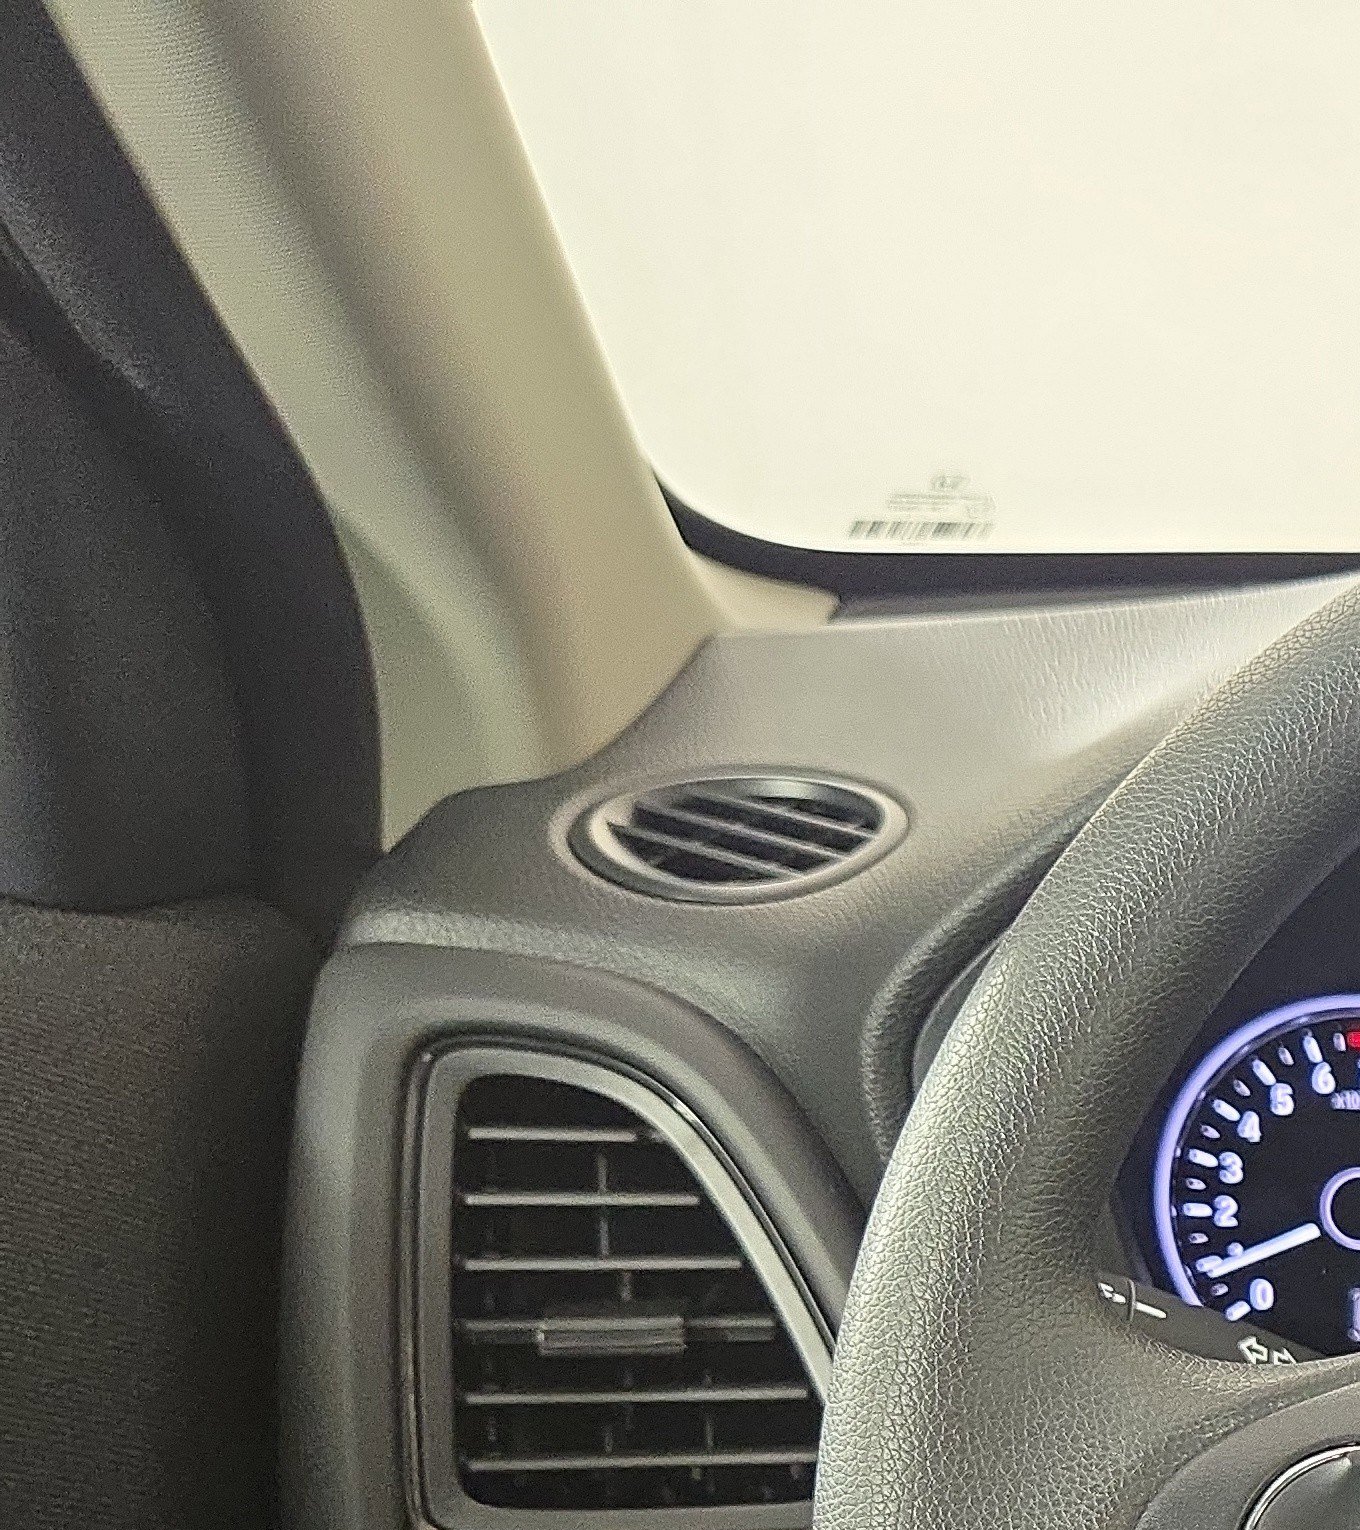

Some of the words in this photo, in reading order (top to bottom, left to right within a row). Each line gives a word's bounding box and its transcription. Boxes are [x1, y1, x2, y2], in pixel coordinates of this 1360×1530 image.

[1312, 1061, 1336, 1095] 6
[1270, 1083, 1294, 1116] 5
[1237, 1110, 1261, 1143] 4
[1219, 1151, 1243, 1184] 3
[1213, 1195, 1238, 1227] 2
[1249, 1277, 1275, 1311] 0
